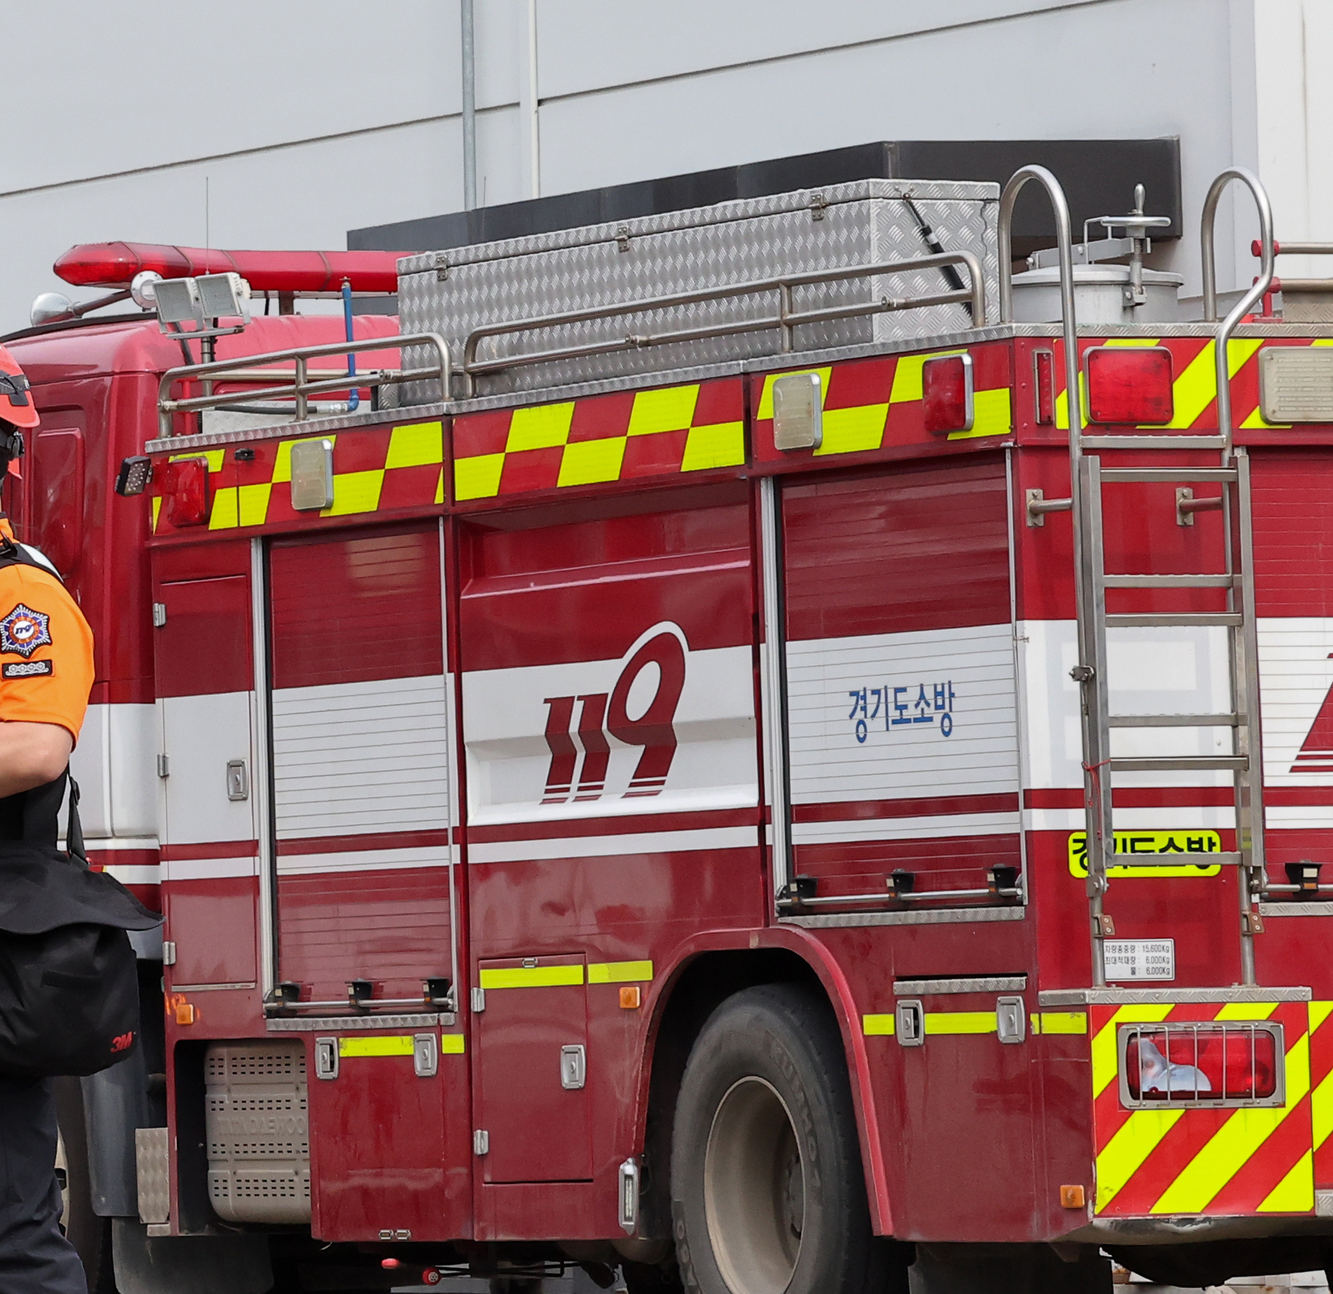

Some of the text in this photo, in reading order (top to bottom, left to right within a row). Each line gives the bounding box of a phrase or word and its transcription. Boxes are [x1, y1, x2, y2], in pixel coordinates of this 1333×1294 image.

[539, 632, 686, 805] 119
[849, 680, 955, 744] 경기도소방
[110, 1031, 133, 1053] 3M
